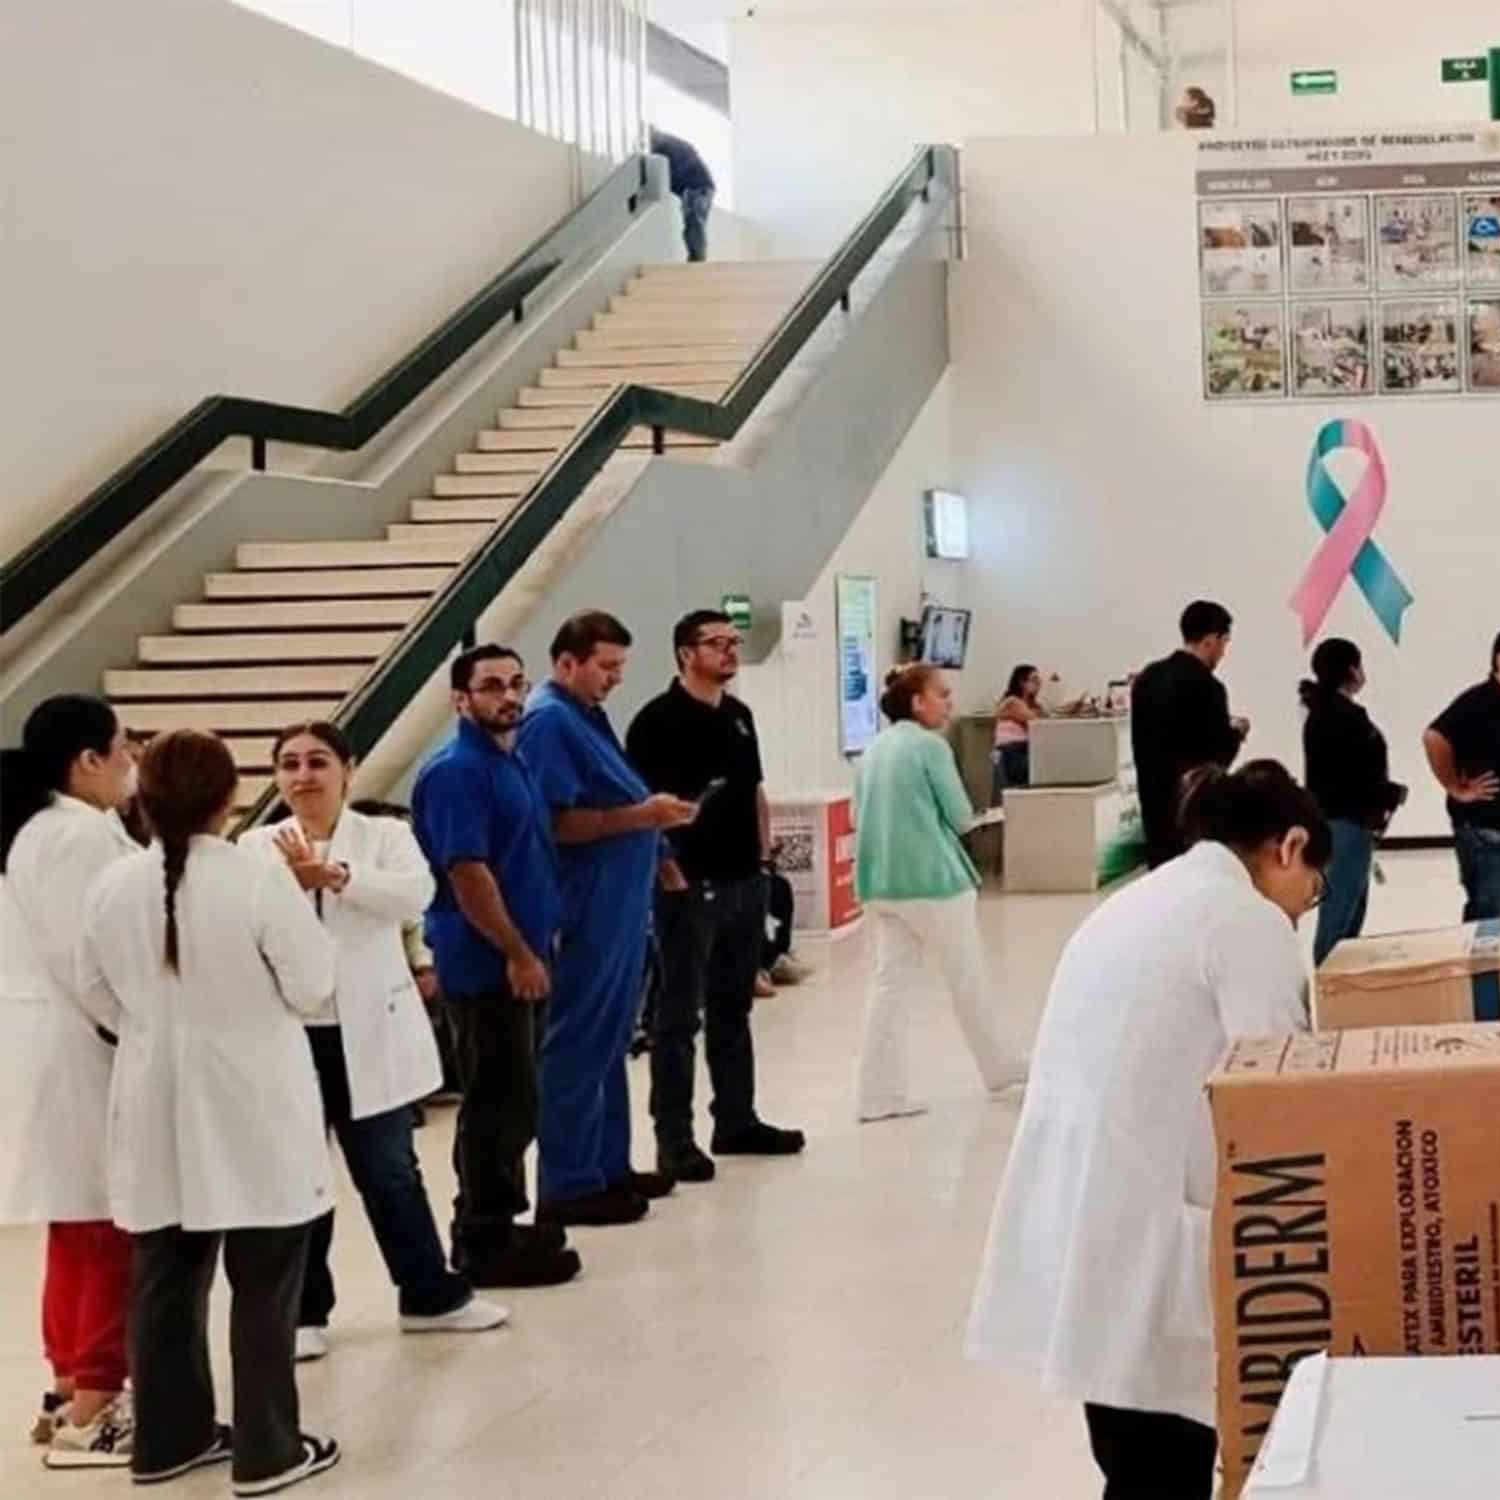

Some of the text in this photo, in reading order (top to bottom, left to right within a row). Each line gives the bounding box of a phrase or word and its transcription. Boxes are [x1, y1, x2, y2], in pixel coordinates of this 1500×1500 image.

[1232, 1153, 1331, 1464] BIDERM
[1396, 1120, 1421, 1355] ATEX PARA EXPLORACION
[1421, 1129, 1447, 1346] AMBIDIESTRO, ATOXICO
